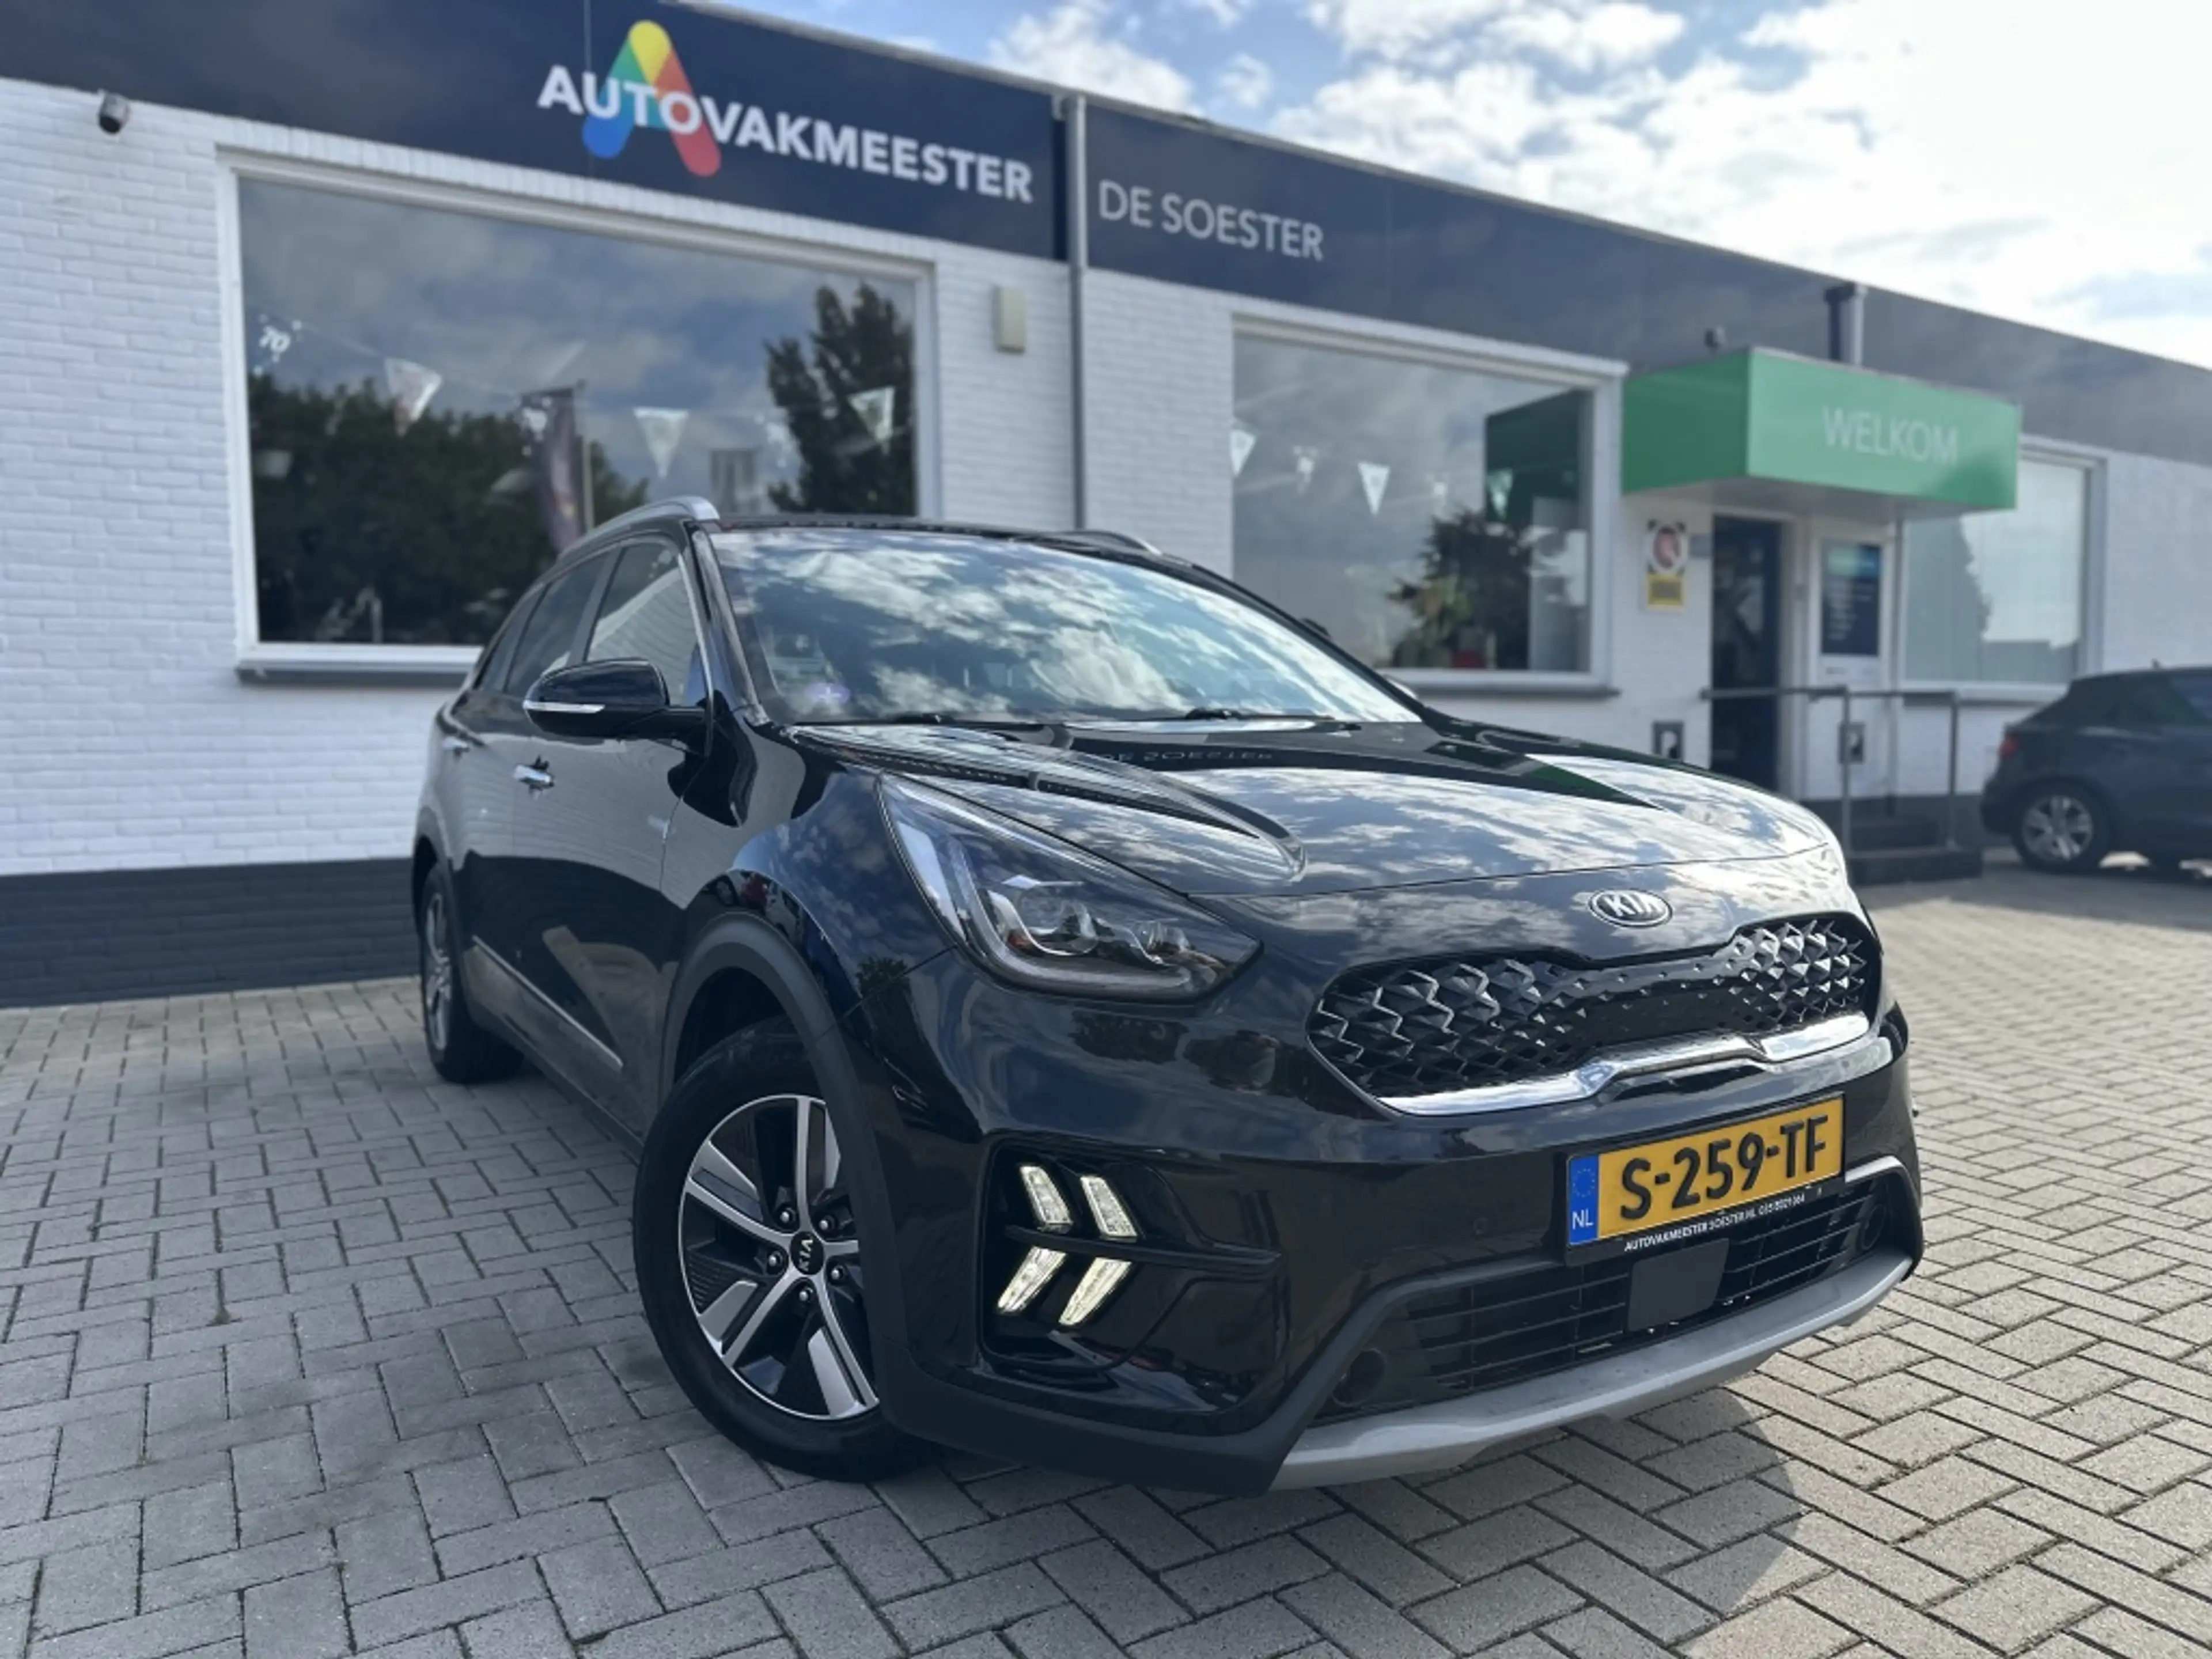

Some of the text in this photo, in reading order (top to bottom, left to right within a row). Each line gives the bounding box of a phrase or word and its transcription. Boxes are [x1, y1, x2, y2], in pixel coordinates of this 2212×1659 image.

[536, 65, 1033, 203] AUTOVAKMEESTER
[1099, 180, 1323, 261] DE SOESTER
[1822, 406, 1957, 464] WELKOM
[1597, 892, 1665, 918] KIA
[1620, 1114, 1828, 1220] S-259-TF
[1571, 1209, 1594, 1230] NL
[798, 1239, 813, 1272] KIA
